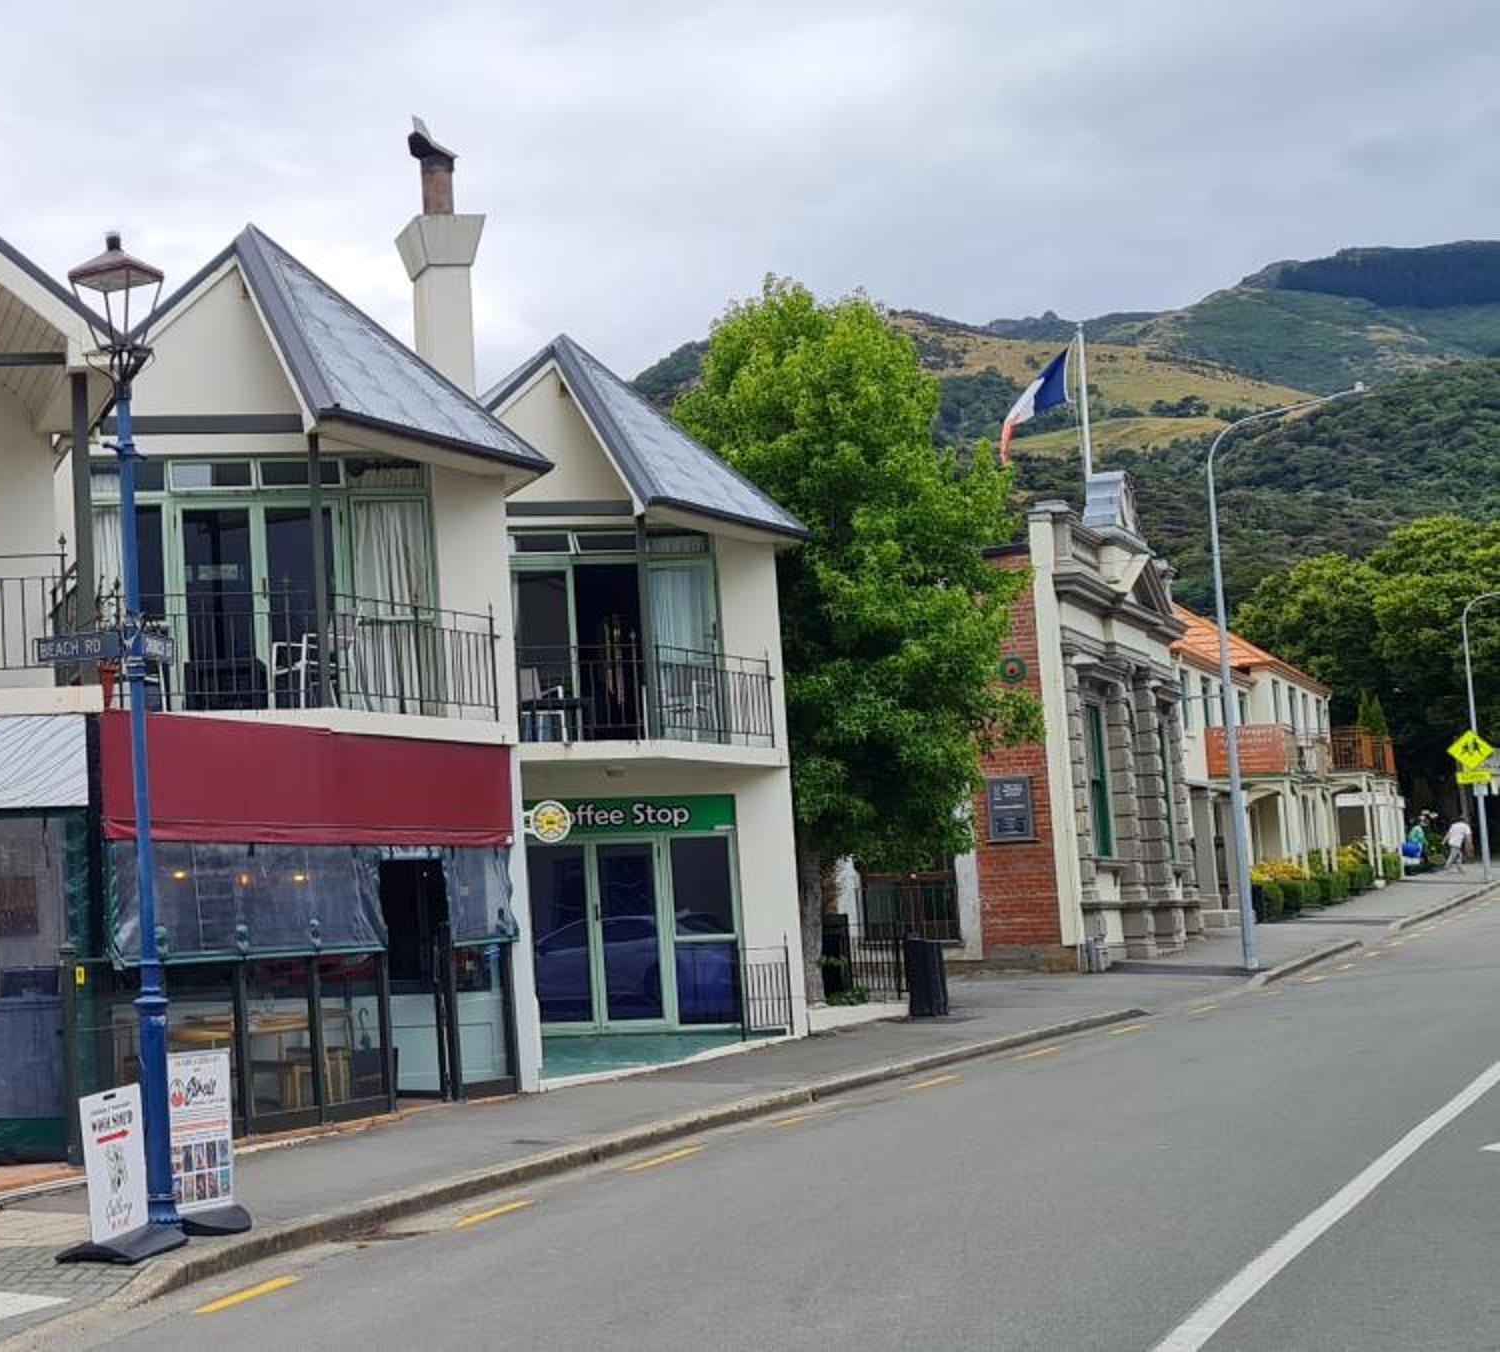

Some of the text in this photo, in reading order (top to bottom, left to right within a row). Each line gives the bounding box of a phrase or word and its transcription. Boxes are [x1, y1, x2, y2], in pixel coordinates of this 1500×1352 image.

[40, 638, 100, 658] BEACH RD
[569, 803, 689, 827] offee Stop
